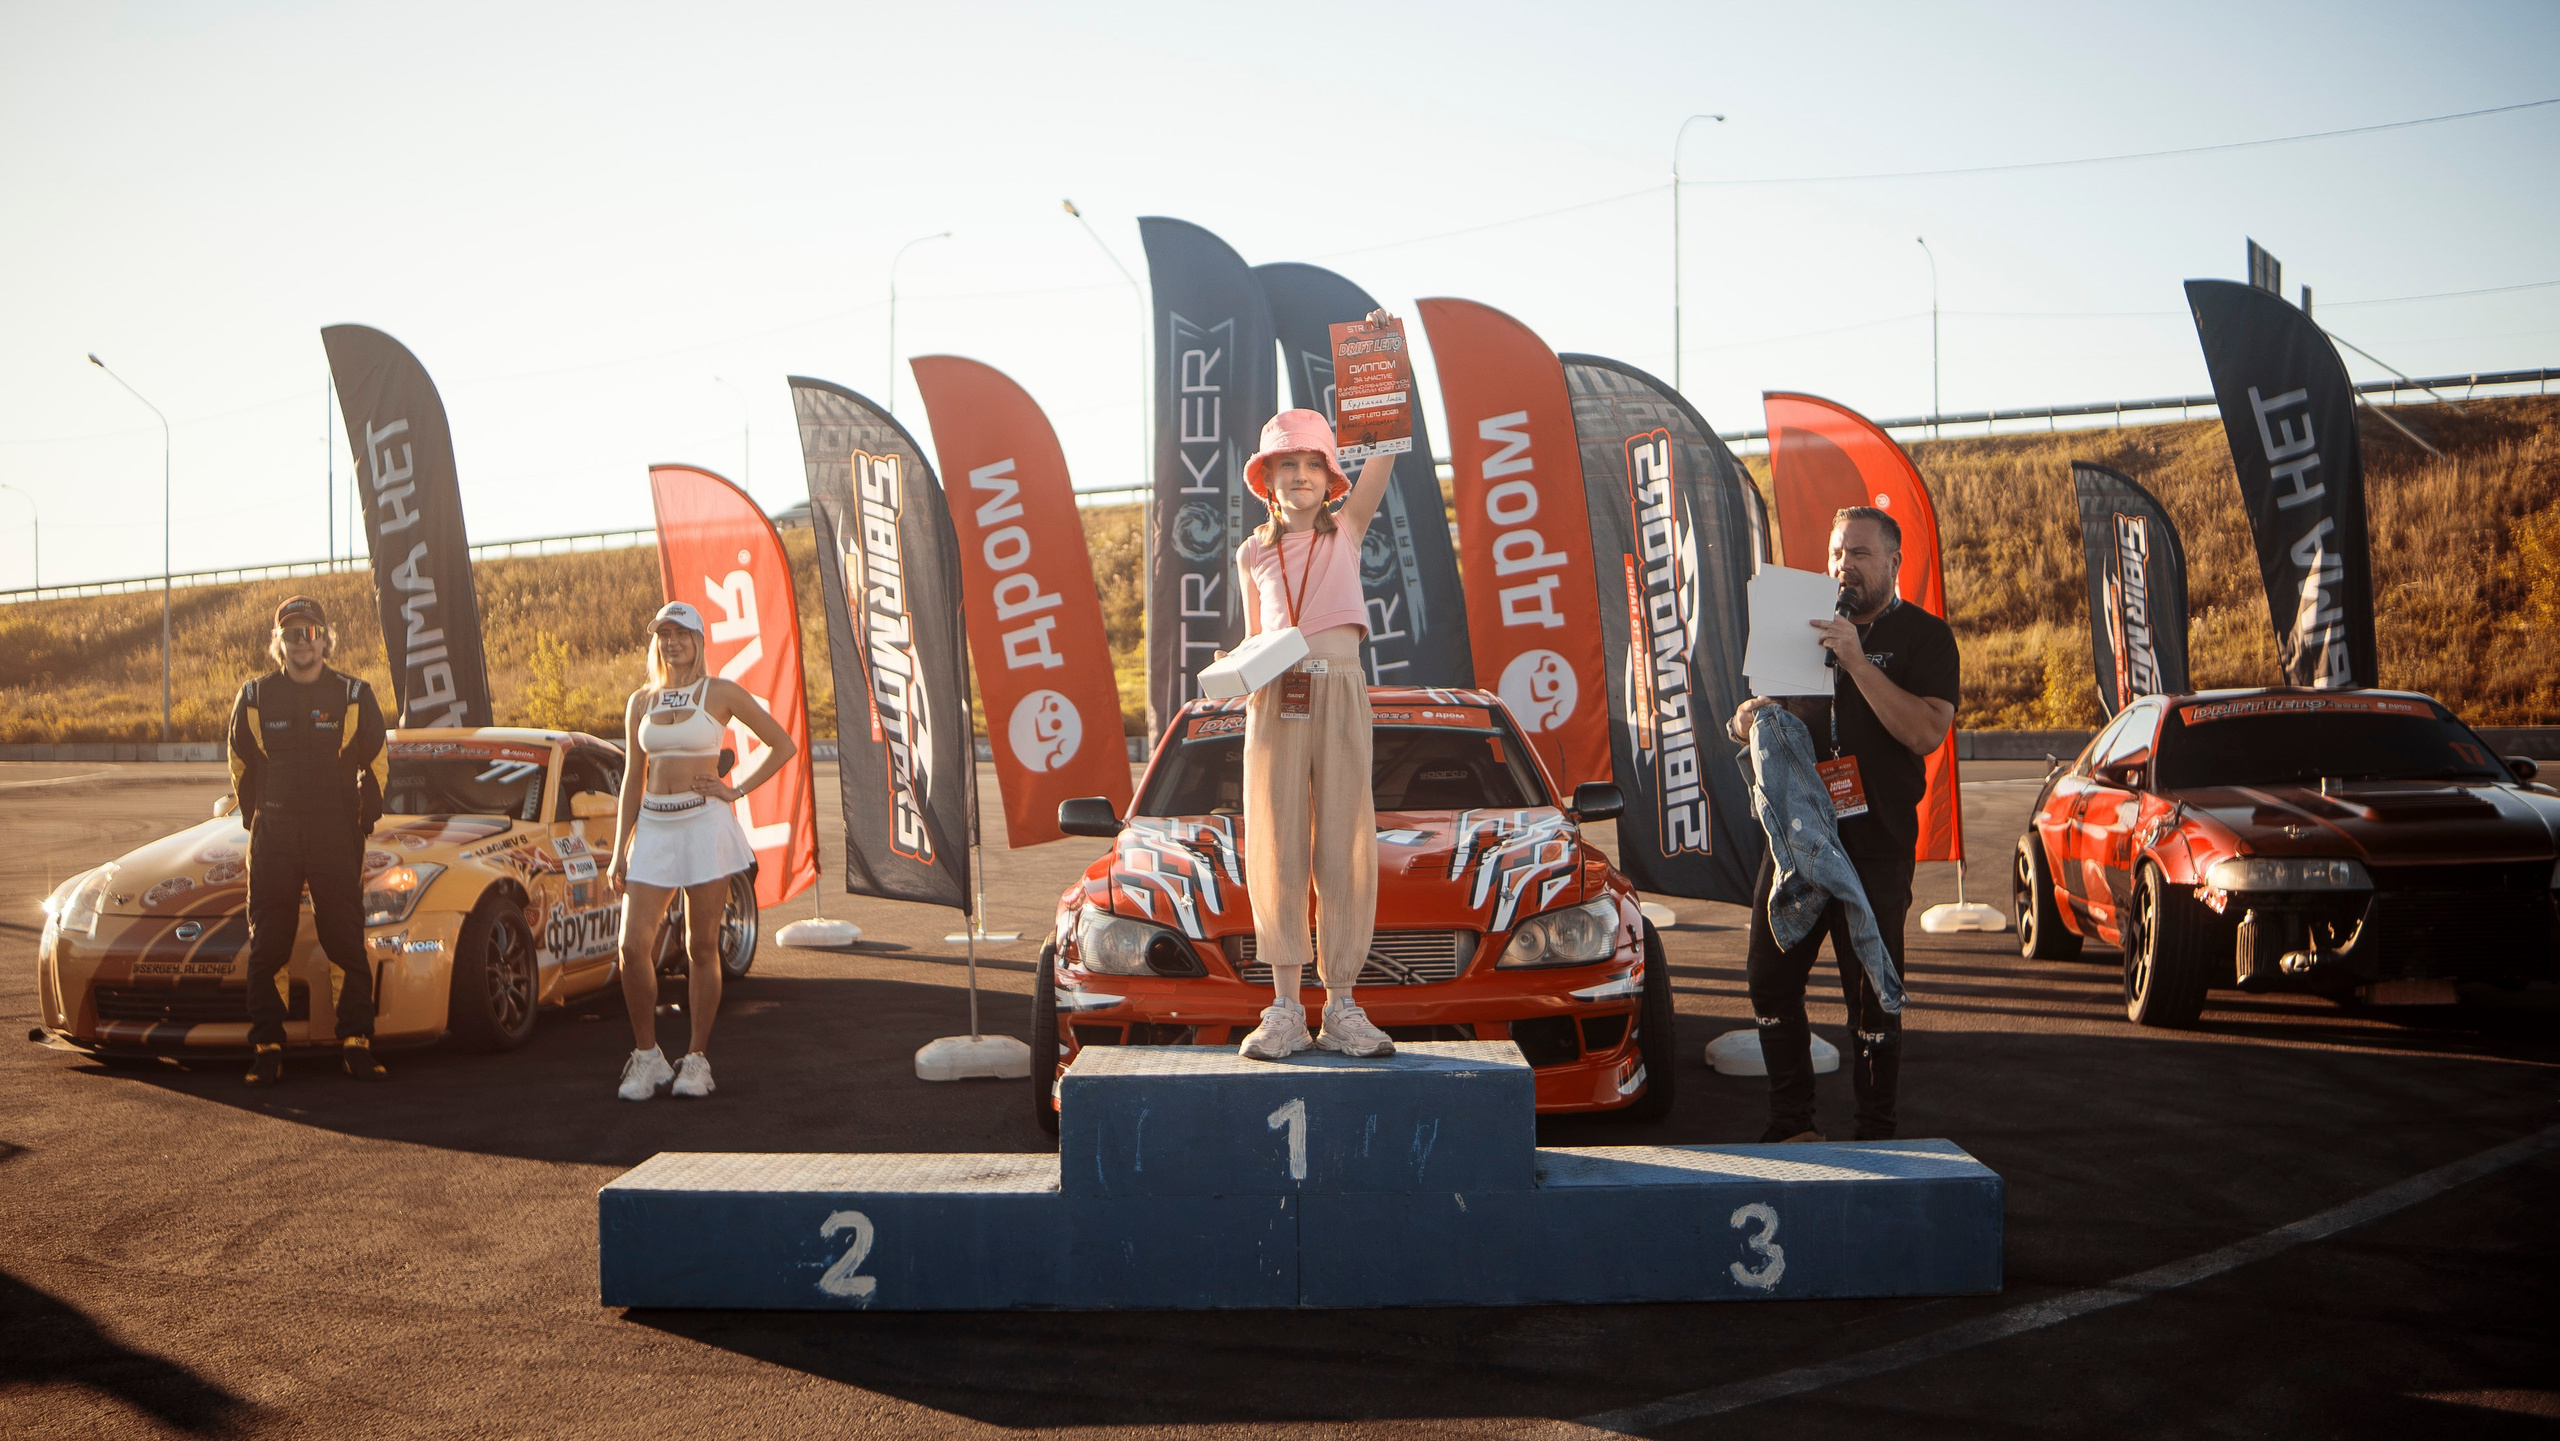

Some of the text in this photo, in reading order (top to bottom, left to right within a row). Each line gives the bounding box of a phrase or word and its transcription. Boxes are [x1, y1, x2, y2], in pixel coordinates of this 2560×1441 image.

[1338, 336, 1403, 357] DRIFT LETO
[1349, 360, 1396, 374] ДИПЛОМ
[1364, 373, 1393, 382] УЧАСТИЕ
[1348, 413, 1365, 421] DRIFT
[1366, 411, 1380, 419] LETO
[2248, 386, 2326, 512] НЕТ
[366, 418, 420, 536] НЕТ
[1393, 515, 1419, 588] TEAM
[2192, 700, 2265, 721] DRIFT
[2266, 697, 2327, 711] LETO
[474, 758, 540, 785] 77
[403, 939, 445, 953] WORK
[1267, 1097, 1307, 1181] 1
[817, 1209, 877, 1299] 2
[1729, 1202, 1787, 1291] 3
